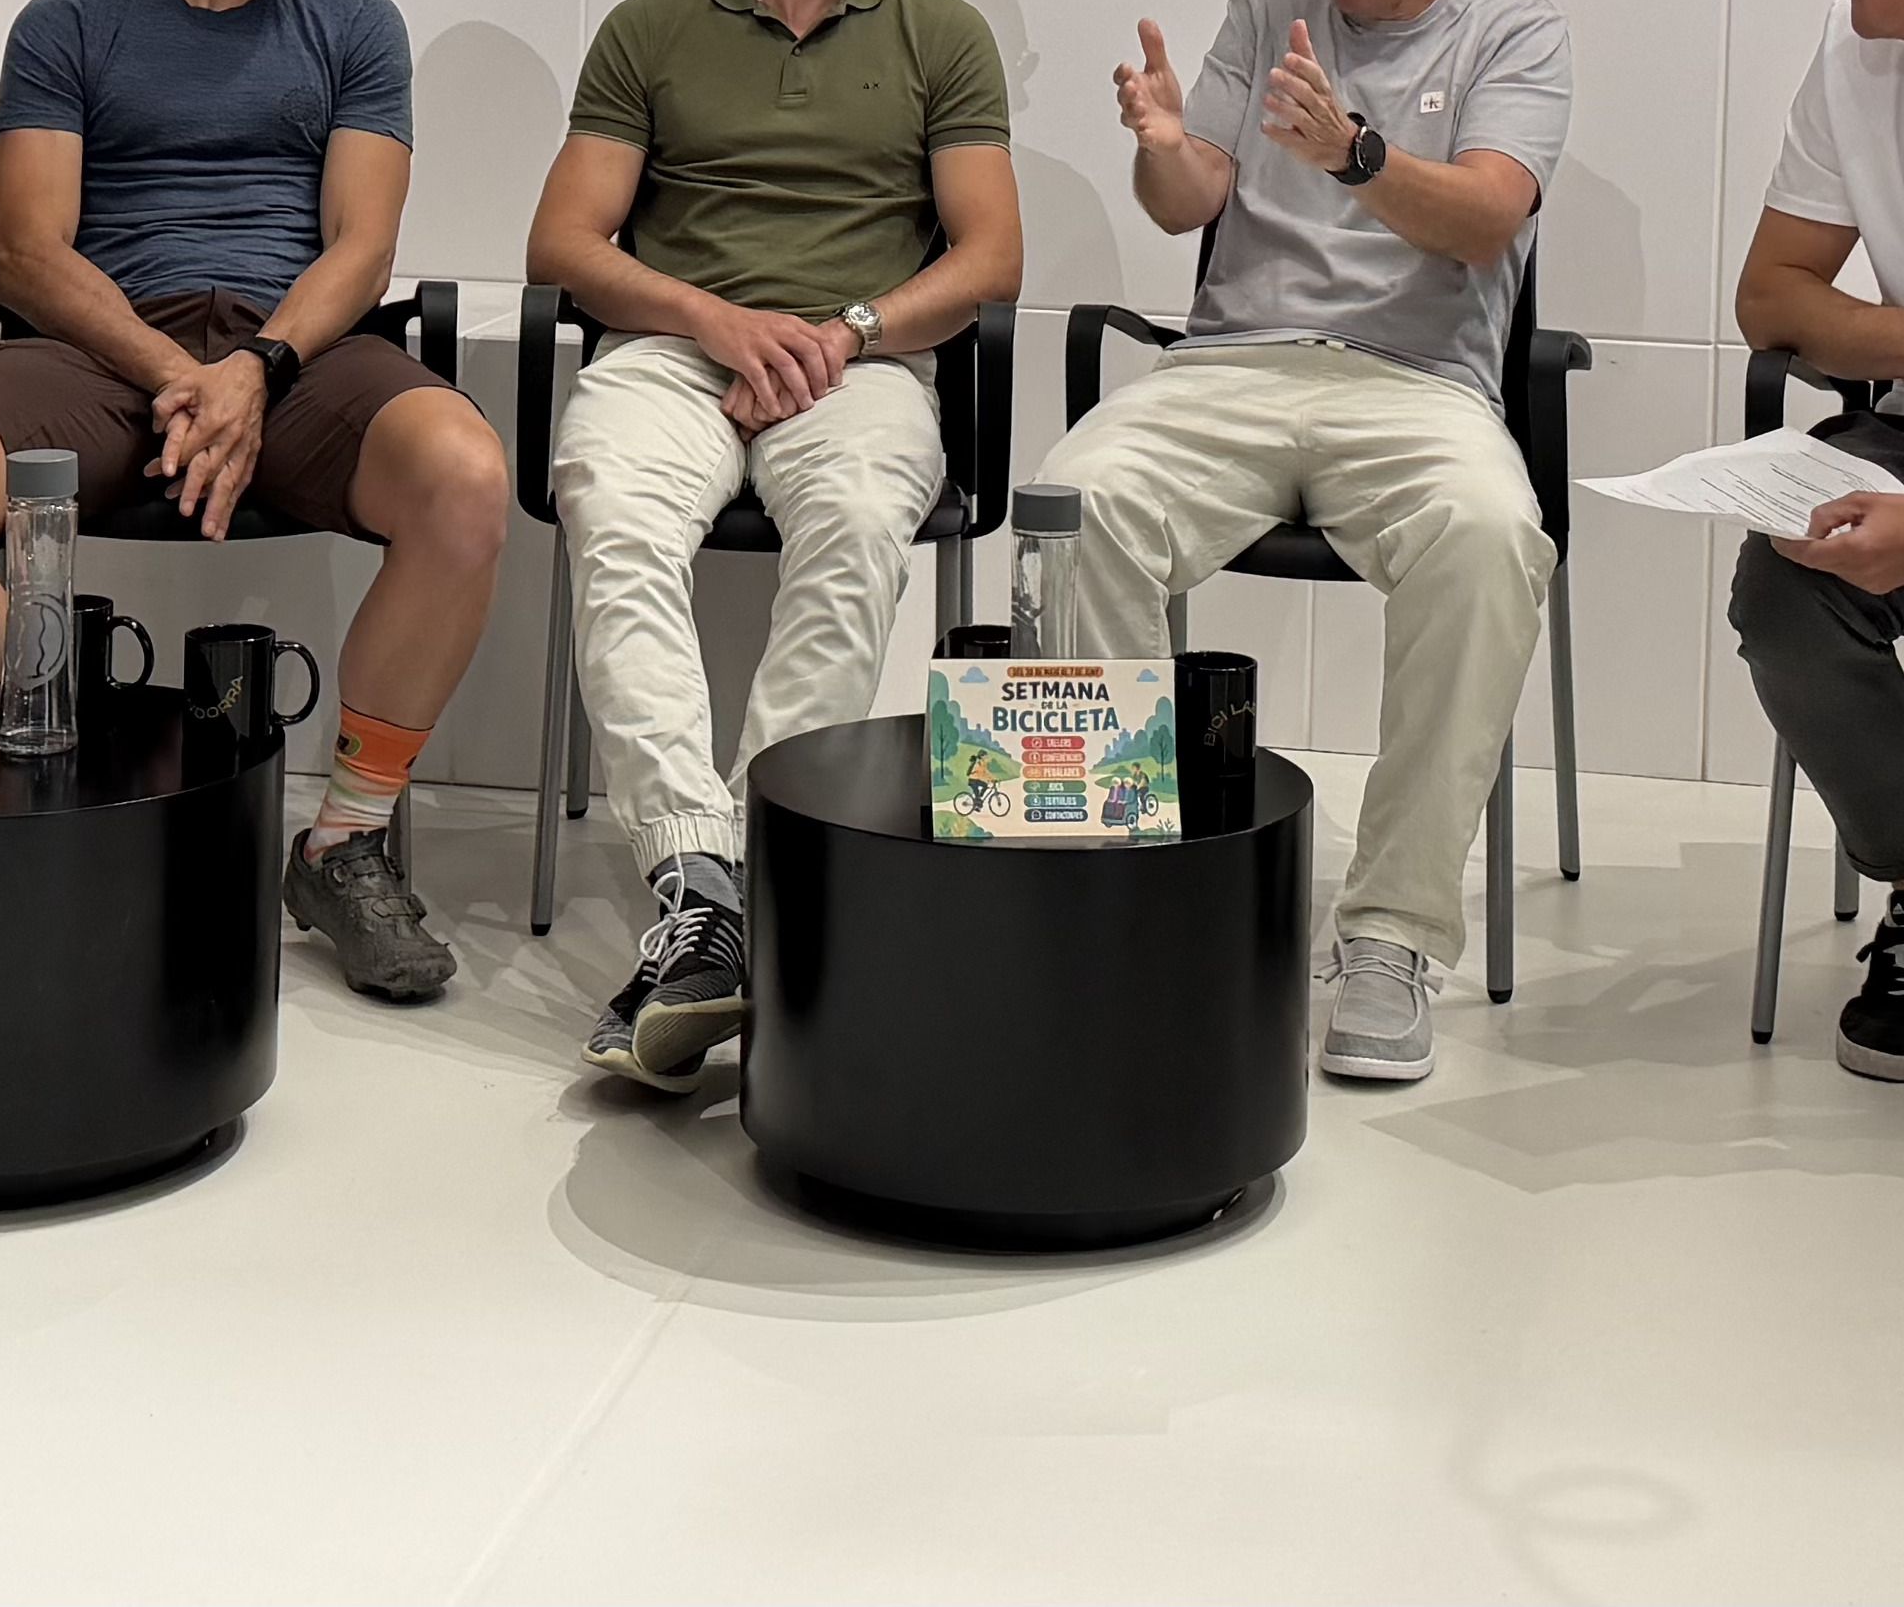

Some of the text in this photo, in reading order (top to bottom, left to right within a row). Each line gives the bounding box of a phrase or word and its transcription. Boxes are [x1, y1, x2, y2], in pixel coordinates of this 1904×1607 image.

[1001, 681, 1110, 702] SETMANA
[1041, 702, 1068, 710] DE LA
[992, 706, 1119, 732] BICICLETA
